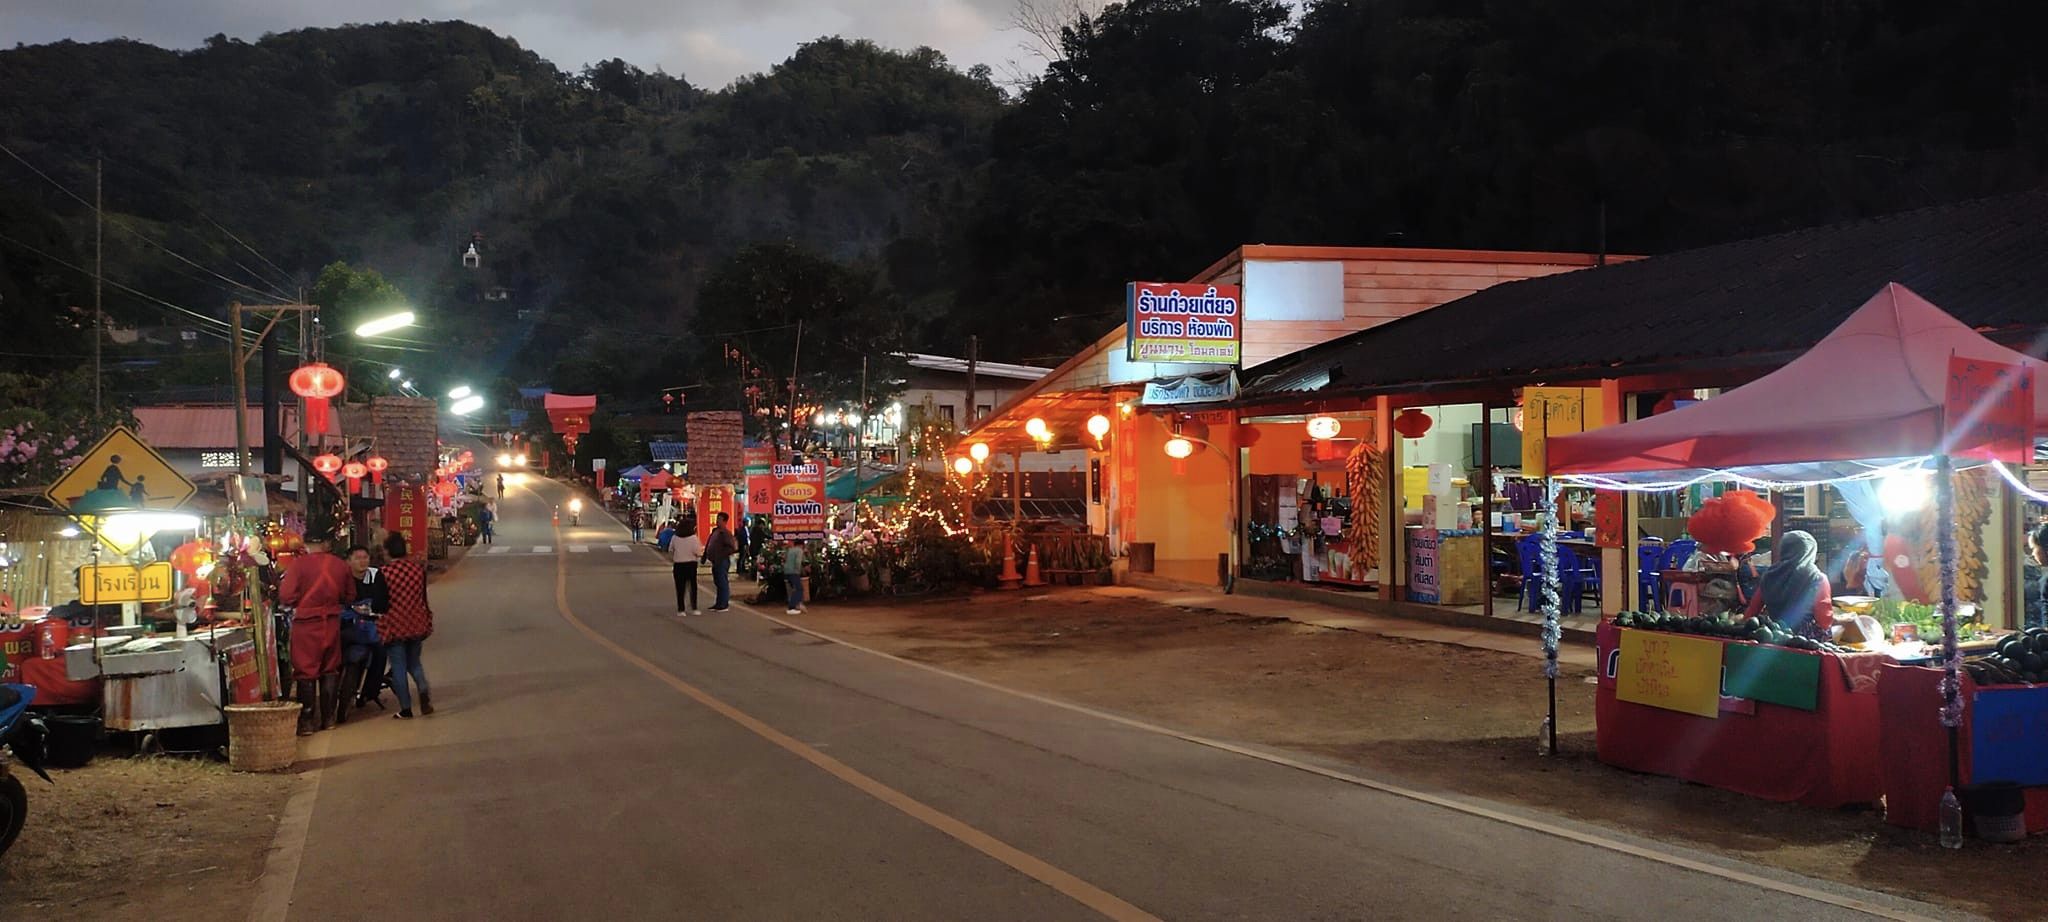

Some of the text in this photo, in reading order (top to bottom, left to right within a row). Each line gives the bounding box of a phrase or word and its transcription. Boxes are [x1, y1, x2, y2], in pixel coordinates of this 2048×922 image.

[1139, 288, 1235, 315] ร้านก๋วยเตี๋ยว
[1142, 318, 1233, 338] บริการ ห้องพัก
[783, 485, 813, 497] บริการ
[775, 499, 822, 516] ห้องพัก
[94, 573, 160, 592] โรงเรียน
